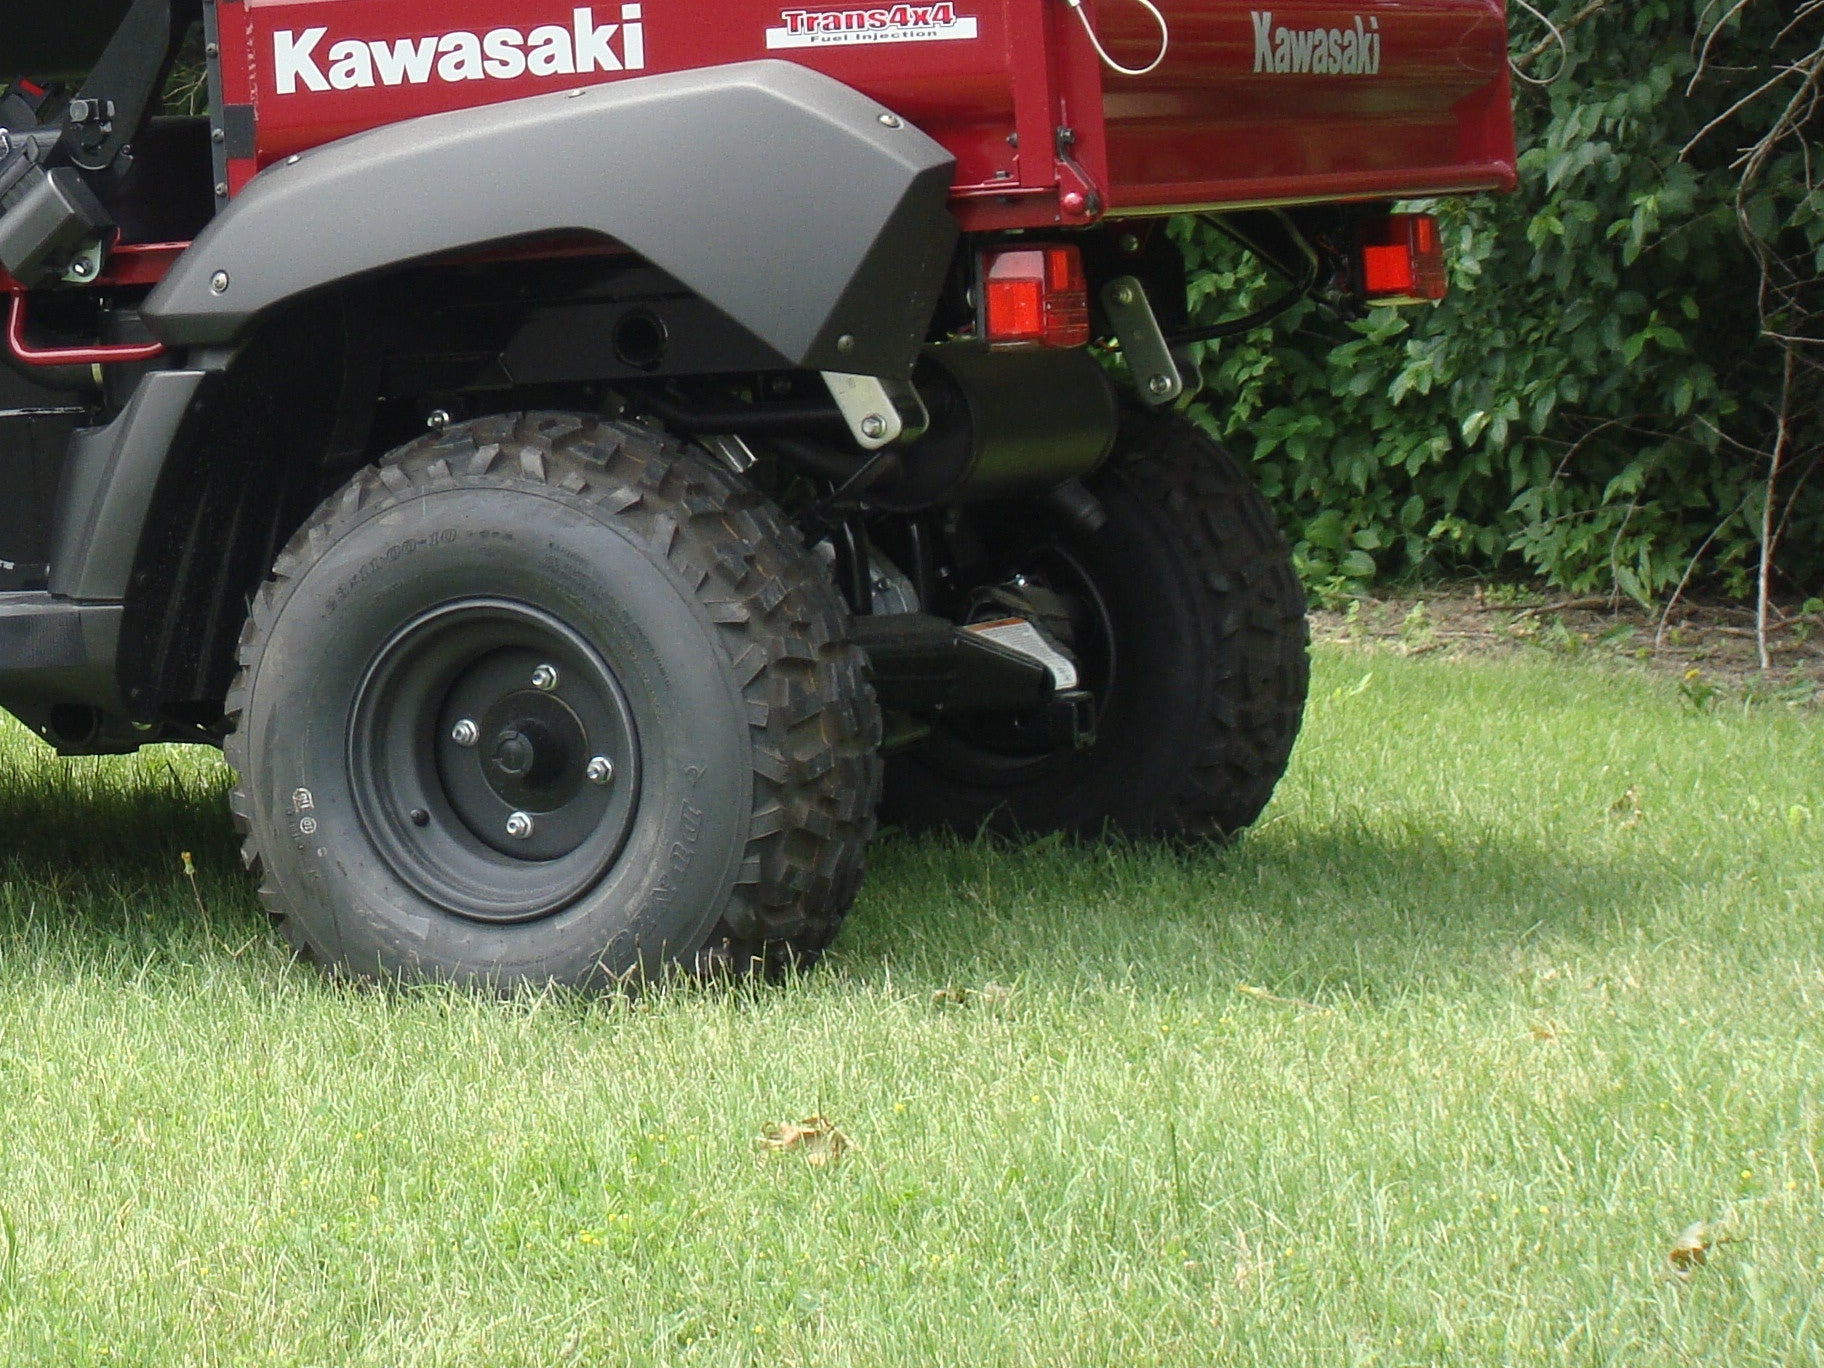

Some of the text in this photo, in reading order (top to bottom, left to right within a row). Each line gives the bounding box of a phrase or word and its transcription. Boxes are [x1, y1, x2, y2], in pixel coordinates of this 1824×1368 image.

[782, 2, 956, 35] Trans4x4
[810, 31, 937, 43] Fuel Injection
[1250, 11, 1380, 74] Kawasaki
[274, 3, 644, 95] Kawasaki
